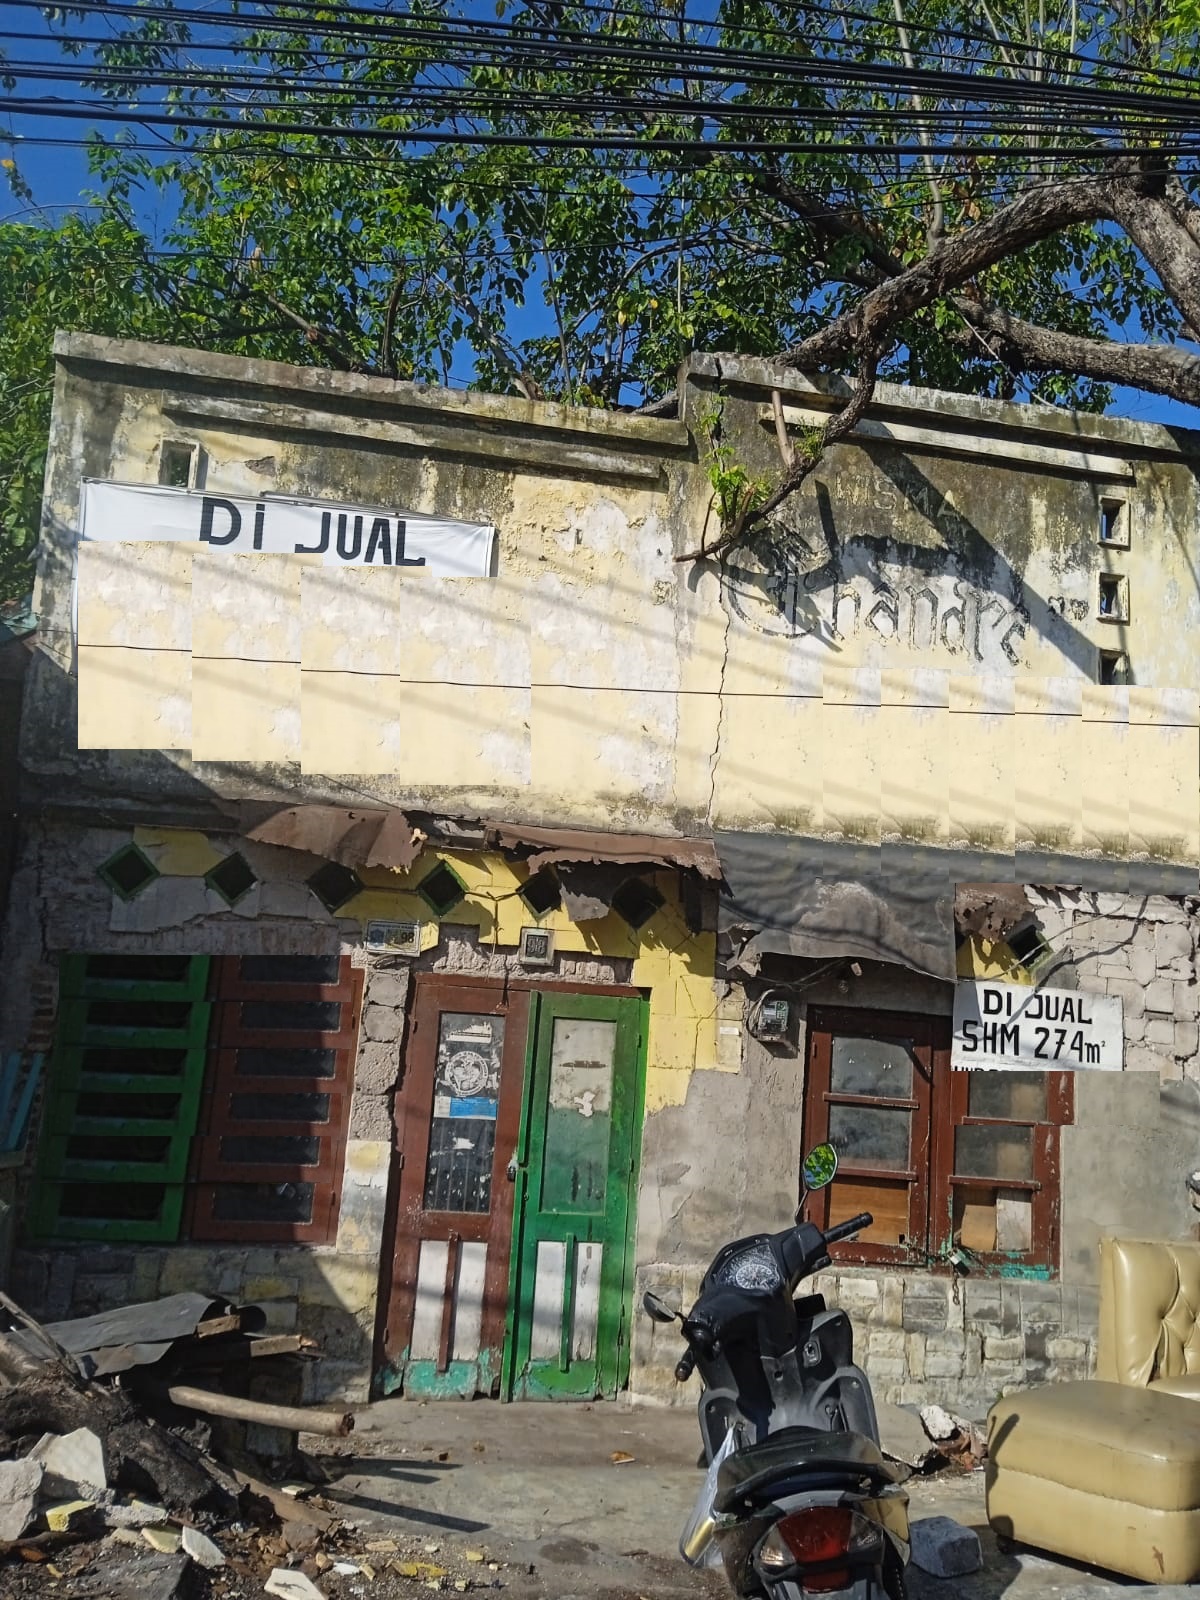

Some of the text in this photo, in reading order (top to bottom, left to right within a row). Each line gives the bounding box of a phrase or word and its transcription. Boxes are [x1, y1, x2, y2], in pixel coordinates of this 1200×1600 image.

[199, 497, 426, 566] Di JUAL
[401, 931, 415, 944] 98
[983, 989, 1093, 1024] DI JUAL
[962, 1020, 1020, 1056] SHM
